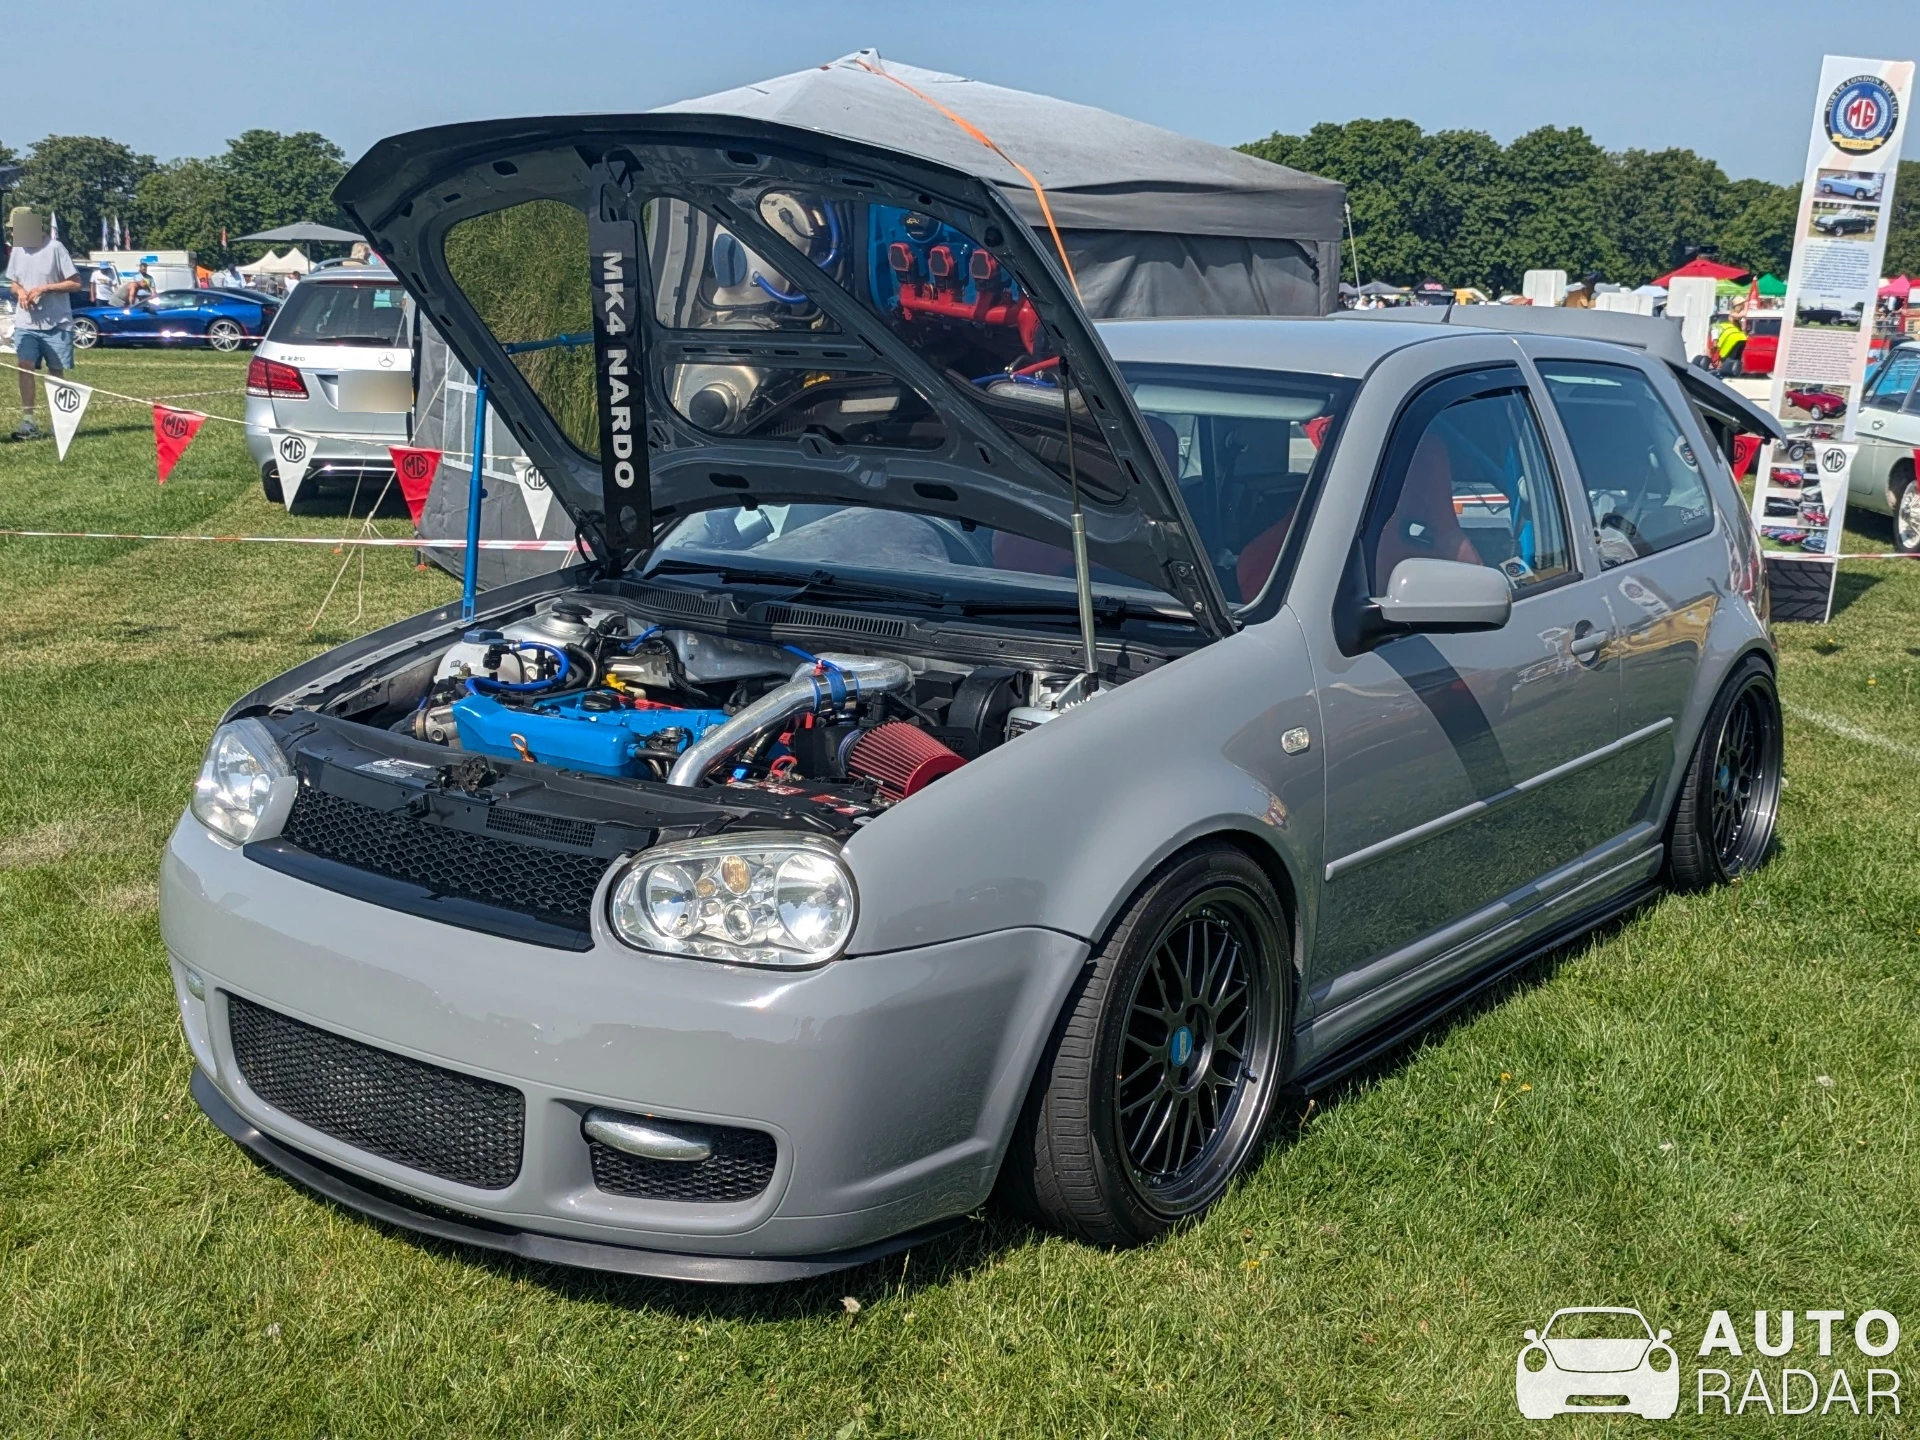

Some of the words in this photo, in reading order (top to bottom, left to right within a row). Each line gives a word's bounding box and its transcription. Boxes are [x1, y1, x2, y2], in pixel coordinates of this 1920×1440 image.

[1825, 85, 1846, 111] NORTH
[1846, 75, 1880, 85] LONDON
[1848, 99, 1876, 129] MG
[602, 250, 626, 335] MK4
[56, 388, 79, 410] MG
[164, 416, 188, 438] MG
[607, 348, 635, 489] NARDO
[282, 439, 304, 461] MG
[1824, 450, 1845, 471] MG
[404, 455, 427, 476] MG
